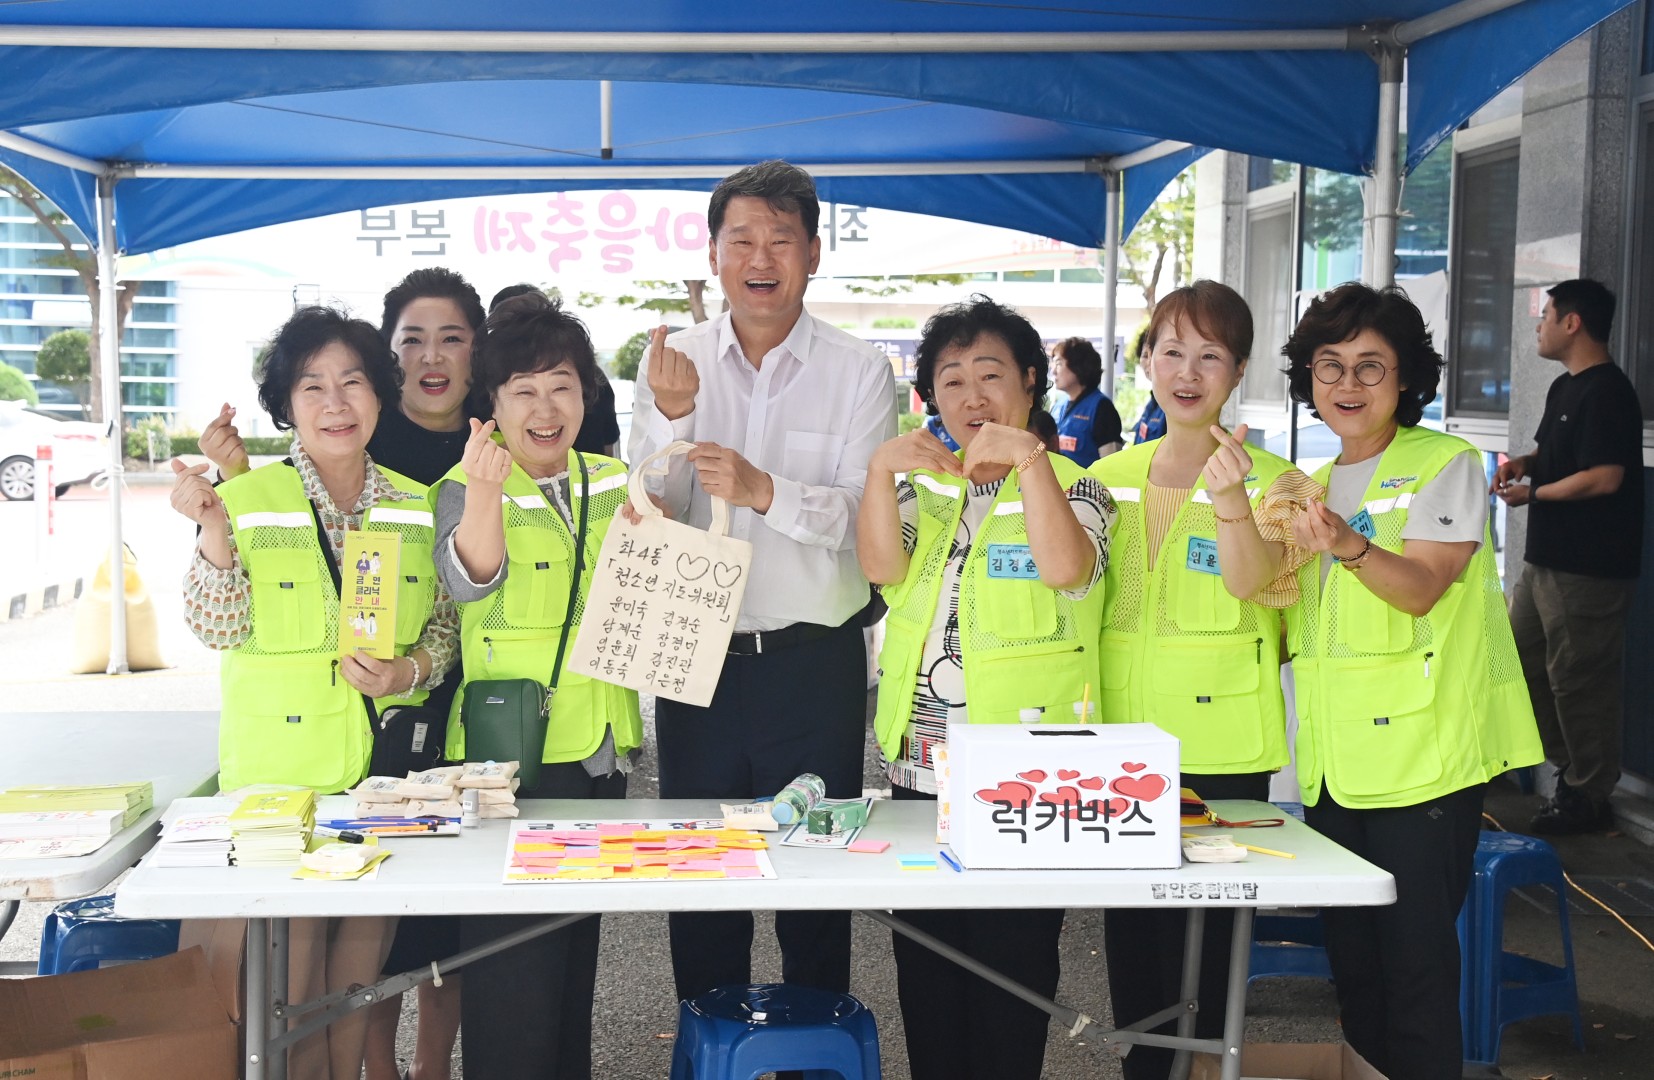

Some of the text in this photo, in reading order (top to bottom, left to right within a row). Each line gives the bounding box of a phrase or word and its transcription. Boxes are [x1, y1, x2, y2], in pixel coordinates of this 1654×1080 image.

[992, 558, 1036, 572] 김경순
[1191, 551, 1217, 567] 임윤
[609, 596, 701, 634] 윤미숙 김경순
[657, 632, 698, 657] 장경미
[589, 656, 686, 694] 이동숙 이은정
[991, 799, 1156, 844] 럭키박스
[12, 1068, 36, 1077] CHAM
